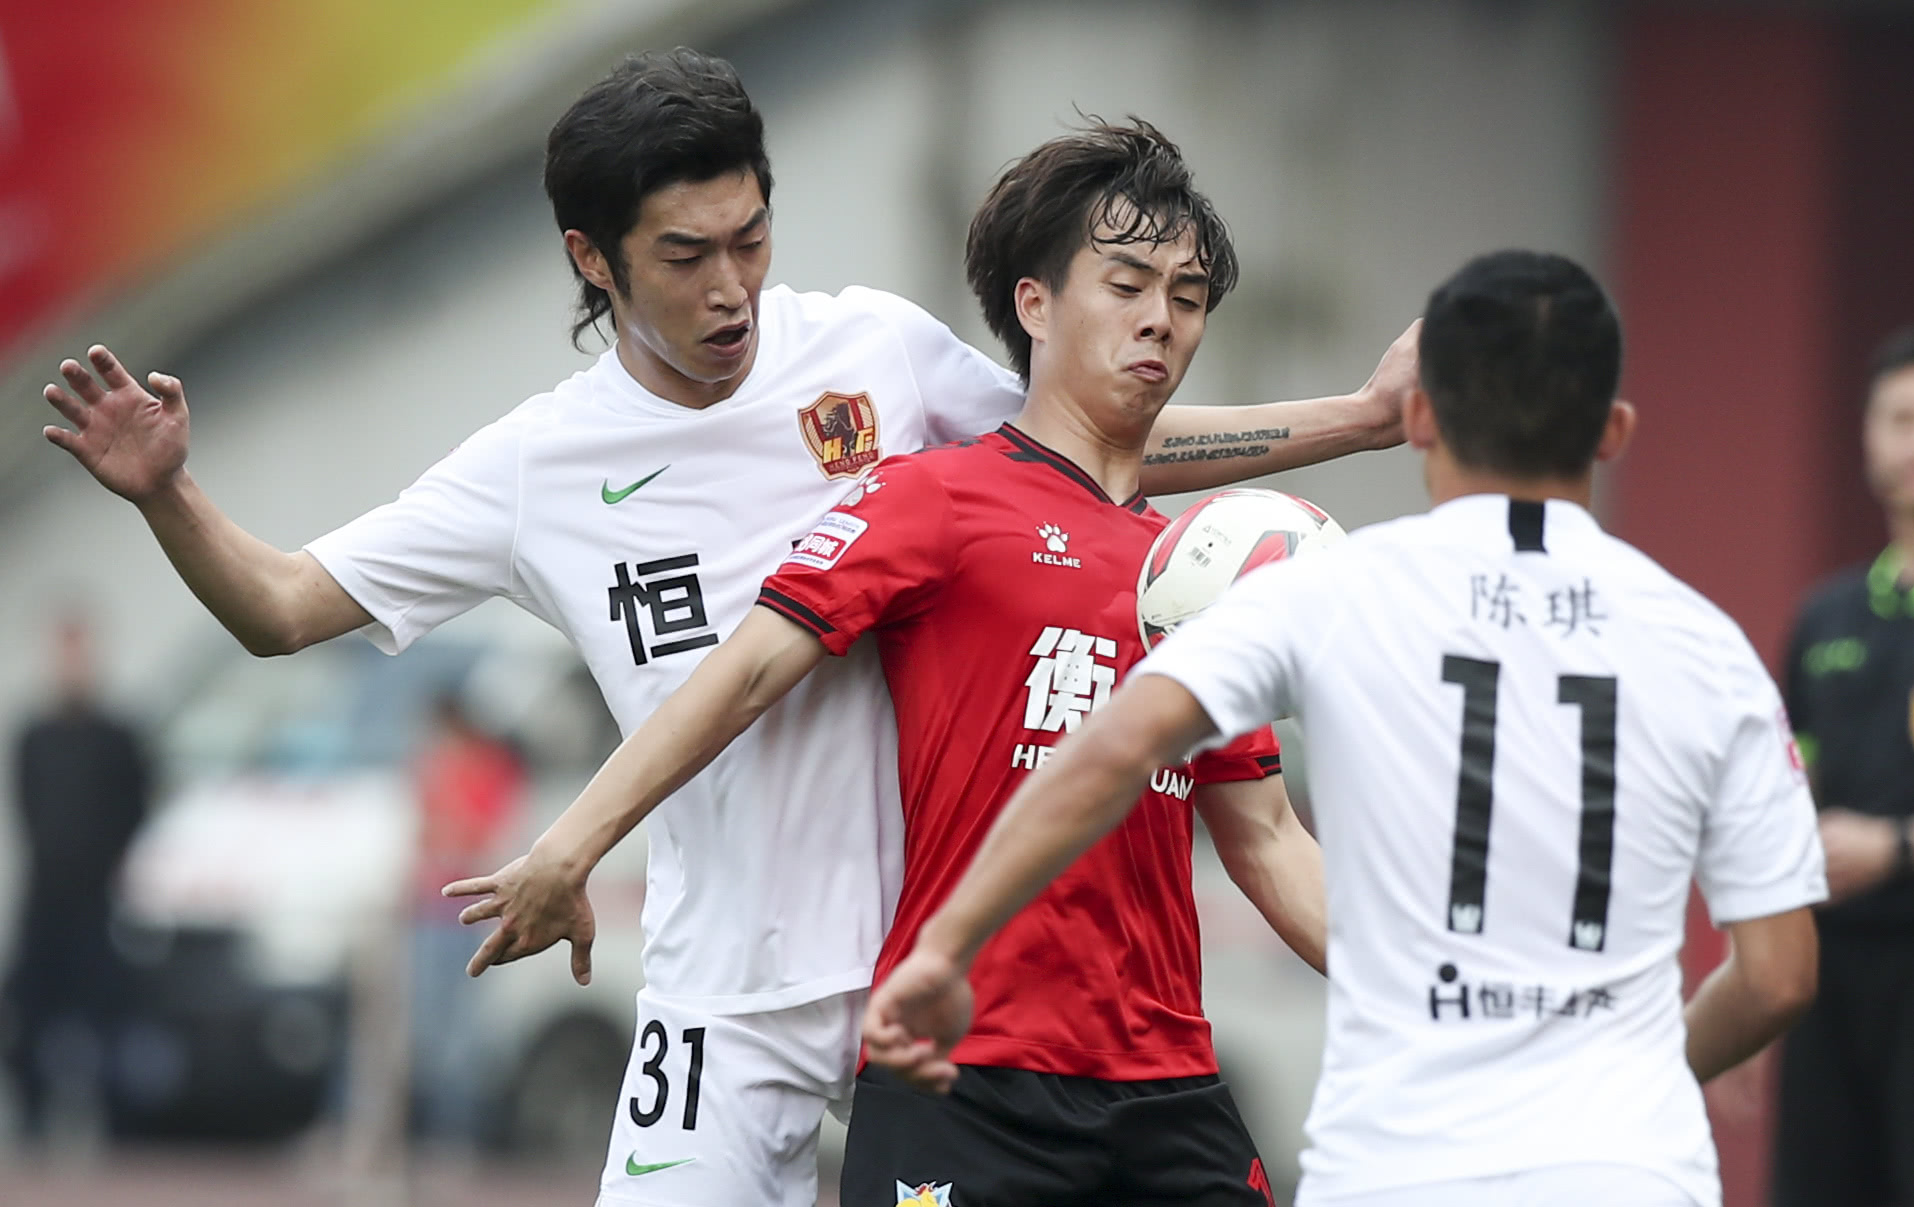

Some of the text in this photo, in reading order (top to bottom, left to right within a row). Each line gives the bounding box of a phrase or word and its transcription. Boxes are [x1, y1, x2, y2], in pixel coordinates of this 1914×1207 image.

[608, 553, 719, 666] 恒
[1032, 551, 1081, 569] KELME
[1441, 652, 1618, 953] 11
[629, 1019, 706, 1131] 31
